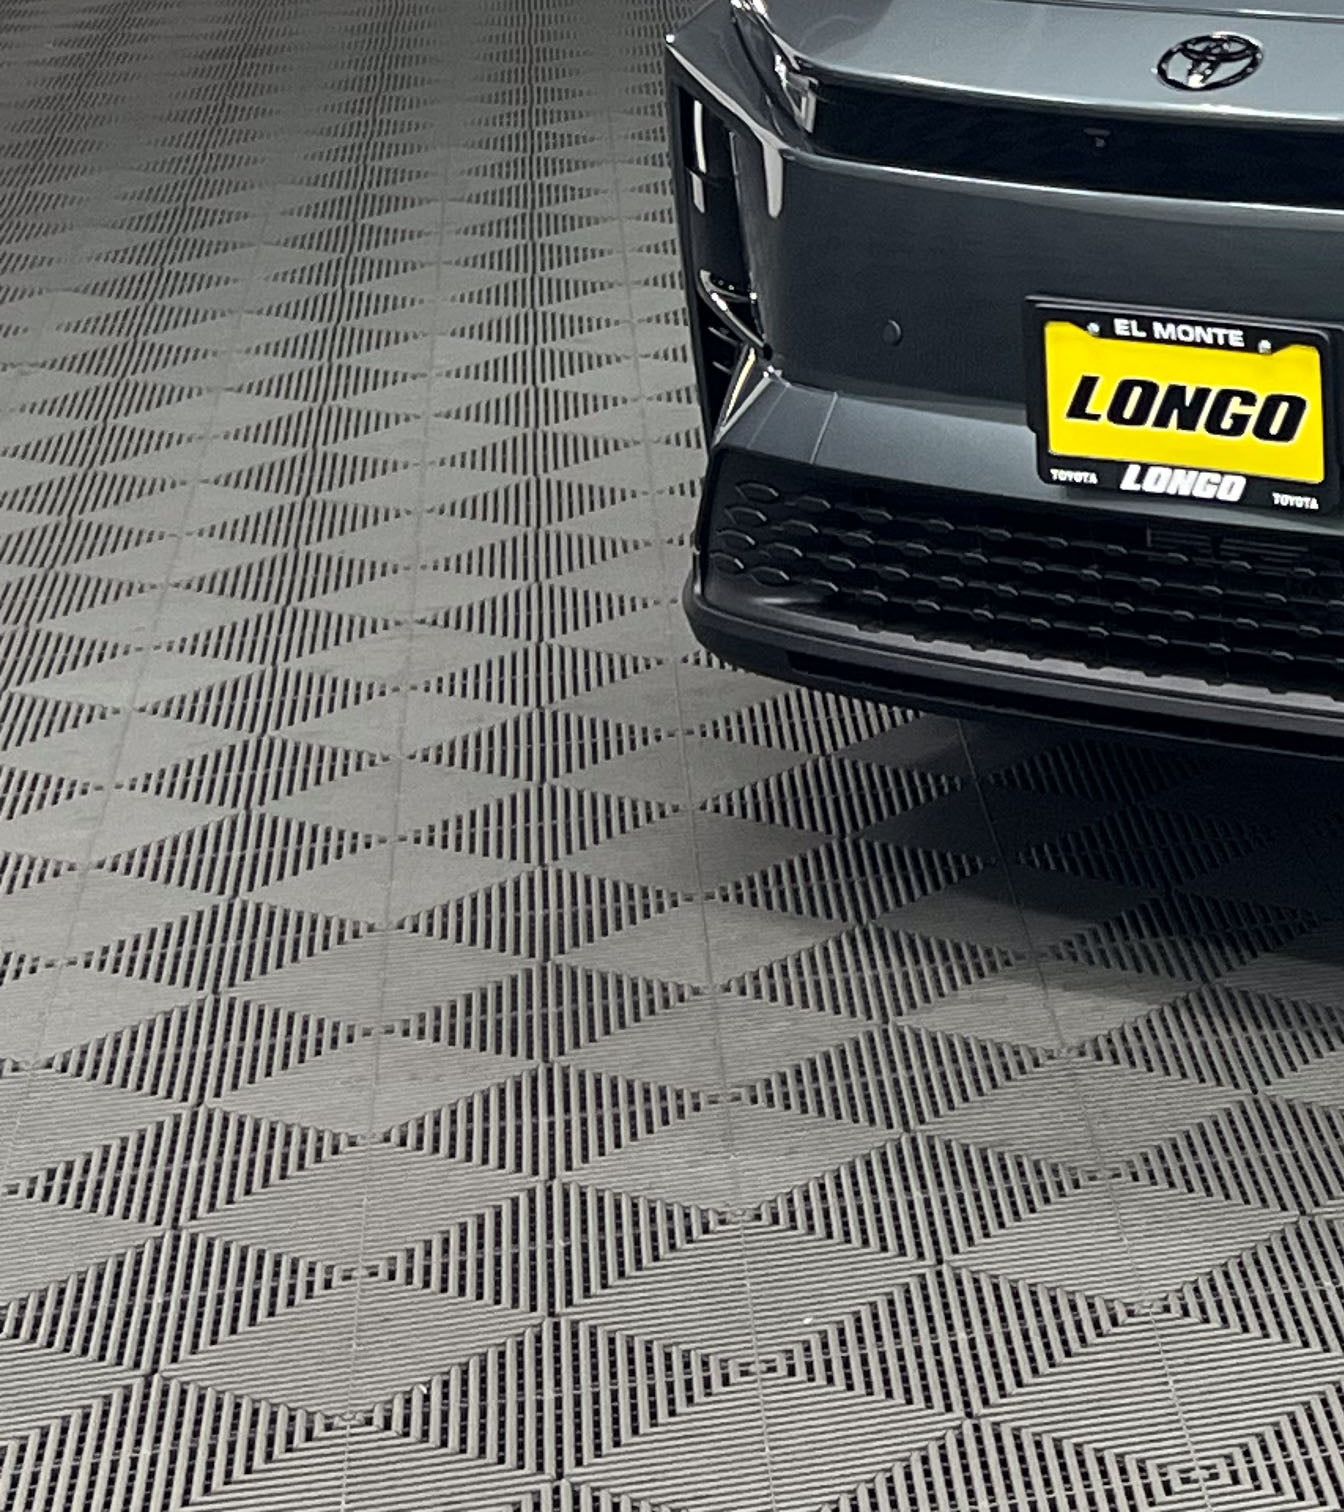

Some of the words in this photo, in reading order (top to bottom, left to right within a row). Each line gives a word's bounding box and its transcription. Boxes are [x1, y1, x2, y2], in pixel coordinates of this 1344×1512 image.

[1113, 318, 1147, 338] EL
[1152, 321, 1245, 347] MONTE
[1065, 374, 1307, 444] LONGO
[1050, 468, 1098, 485] TOYOTA
[1120, 464, 1247, 503] LONGO
[1272, 492, 1319, 511] TOYOTA
